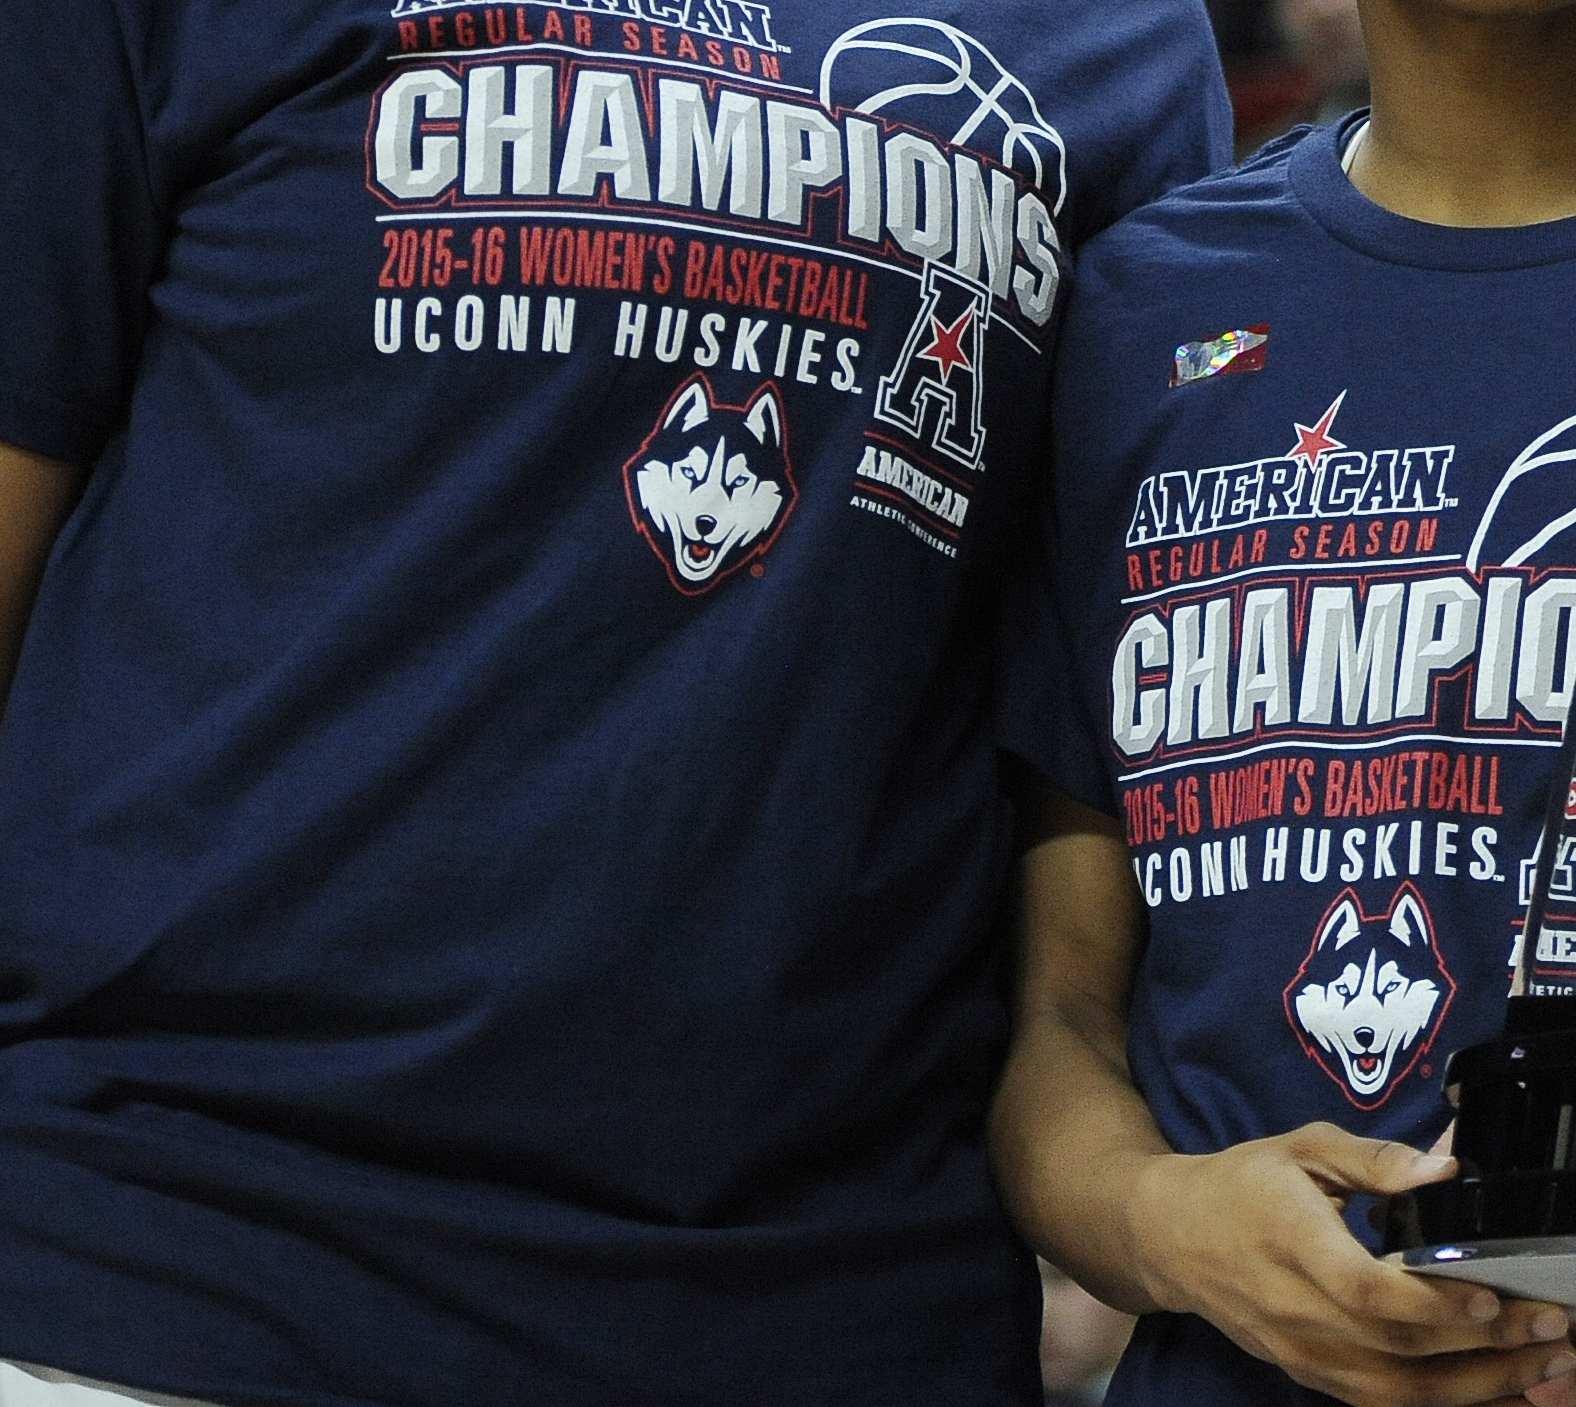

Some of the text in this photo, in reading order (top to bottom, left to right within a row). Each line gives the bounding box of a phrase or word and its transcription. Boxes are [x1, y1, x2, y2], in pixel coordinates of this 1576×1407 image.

[397, 6, 782, 81] REGULAR SEASON
[374, 64, 1061, 327] CHAMPIONS
[378, 226, 868, 329] 2015-16 WOMEN'S BASKETBALL
[374, 294, 862, 393] UCONN HUSKIES
[850, 495, 957, 559] ATHLETIC CONFERENCE
[856, 445, 969, 528] AMERICAN
[1126, 445, 1456, 548] AMERICAN
[1126, 518, 1440, 591] REGULAR SEASON
[1123, 751, 1504, 847] 2015-16 WOMEN'S BASKETBALL
[1262, 820, 1500, 883] HUSKIES
